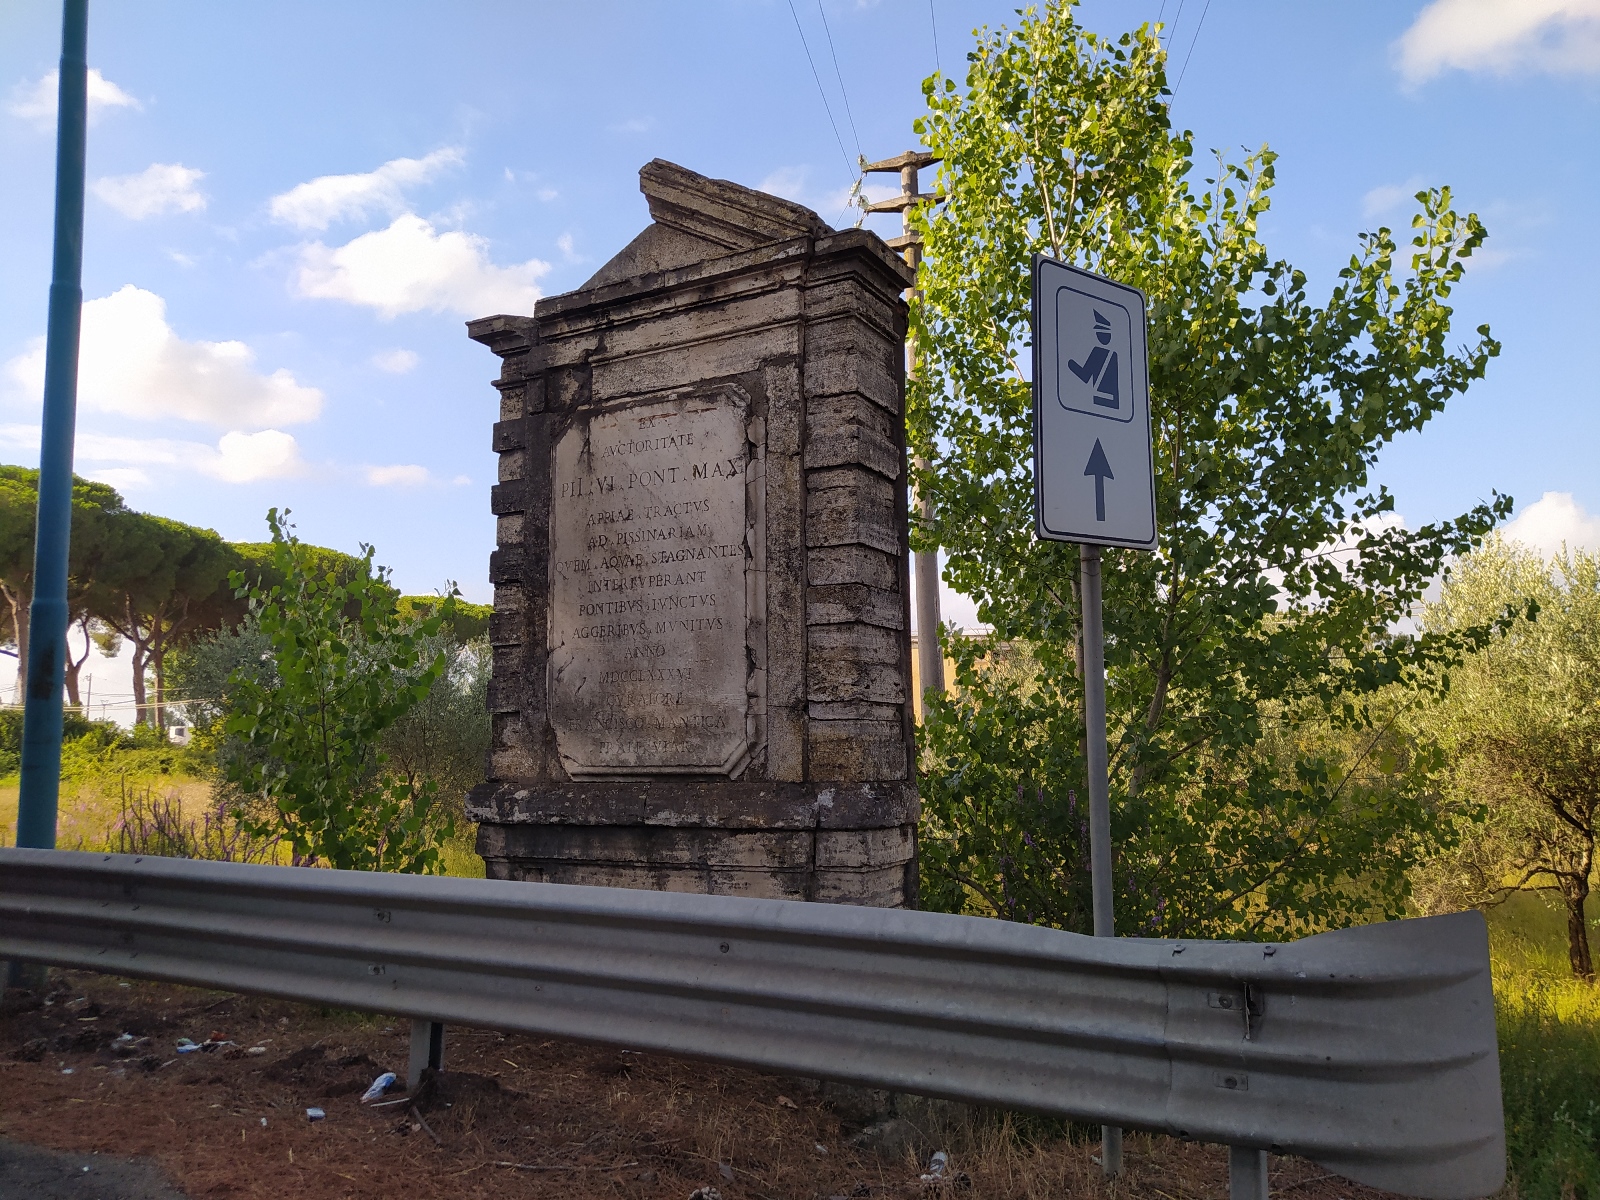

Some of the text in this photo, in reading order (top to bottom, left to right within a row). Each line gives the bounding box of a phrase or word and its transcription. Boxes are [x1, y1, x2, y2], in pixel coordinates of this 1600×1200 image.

[639, 416, 656, 430] EX
[601, 432, 694, 459] AVCTORITATE
[561, 458, 740, 499] PII VI PONT MAX
[587, 498, 711, 528] APPIAE TRACTVS
[600, 553, 644, 575] AQVAE
[651, 543, 745, 565] STAGNANTES
[578, 593, 717, 617] PONTIBVS IVNCTVS
[572, 617, 724, 640] AGGERIBVS MVNITVS
[624, 645, 666, 660] ANNO
[599, 667, 692, 684] MDCCLXXXVI
